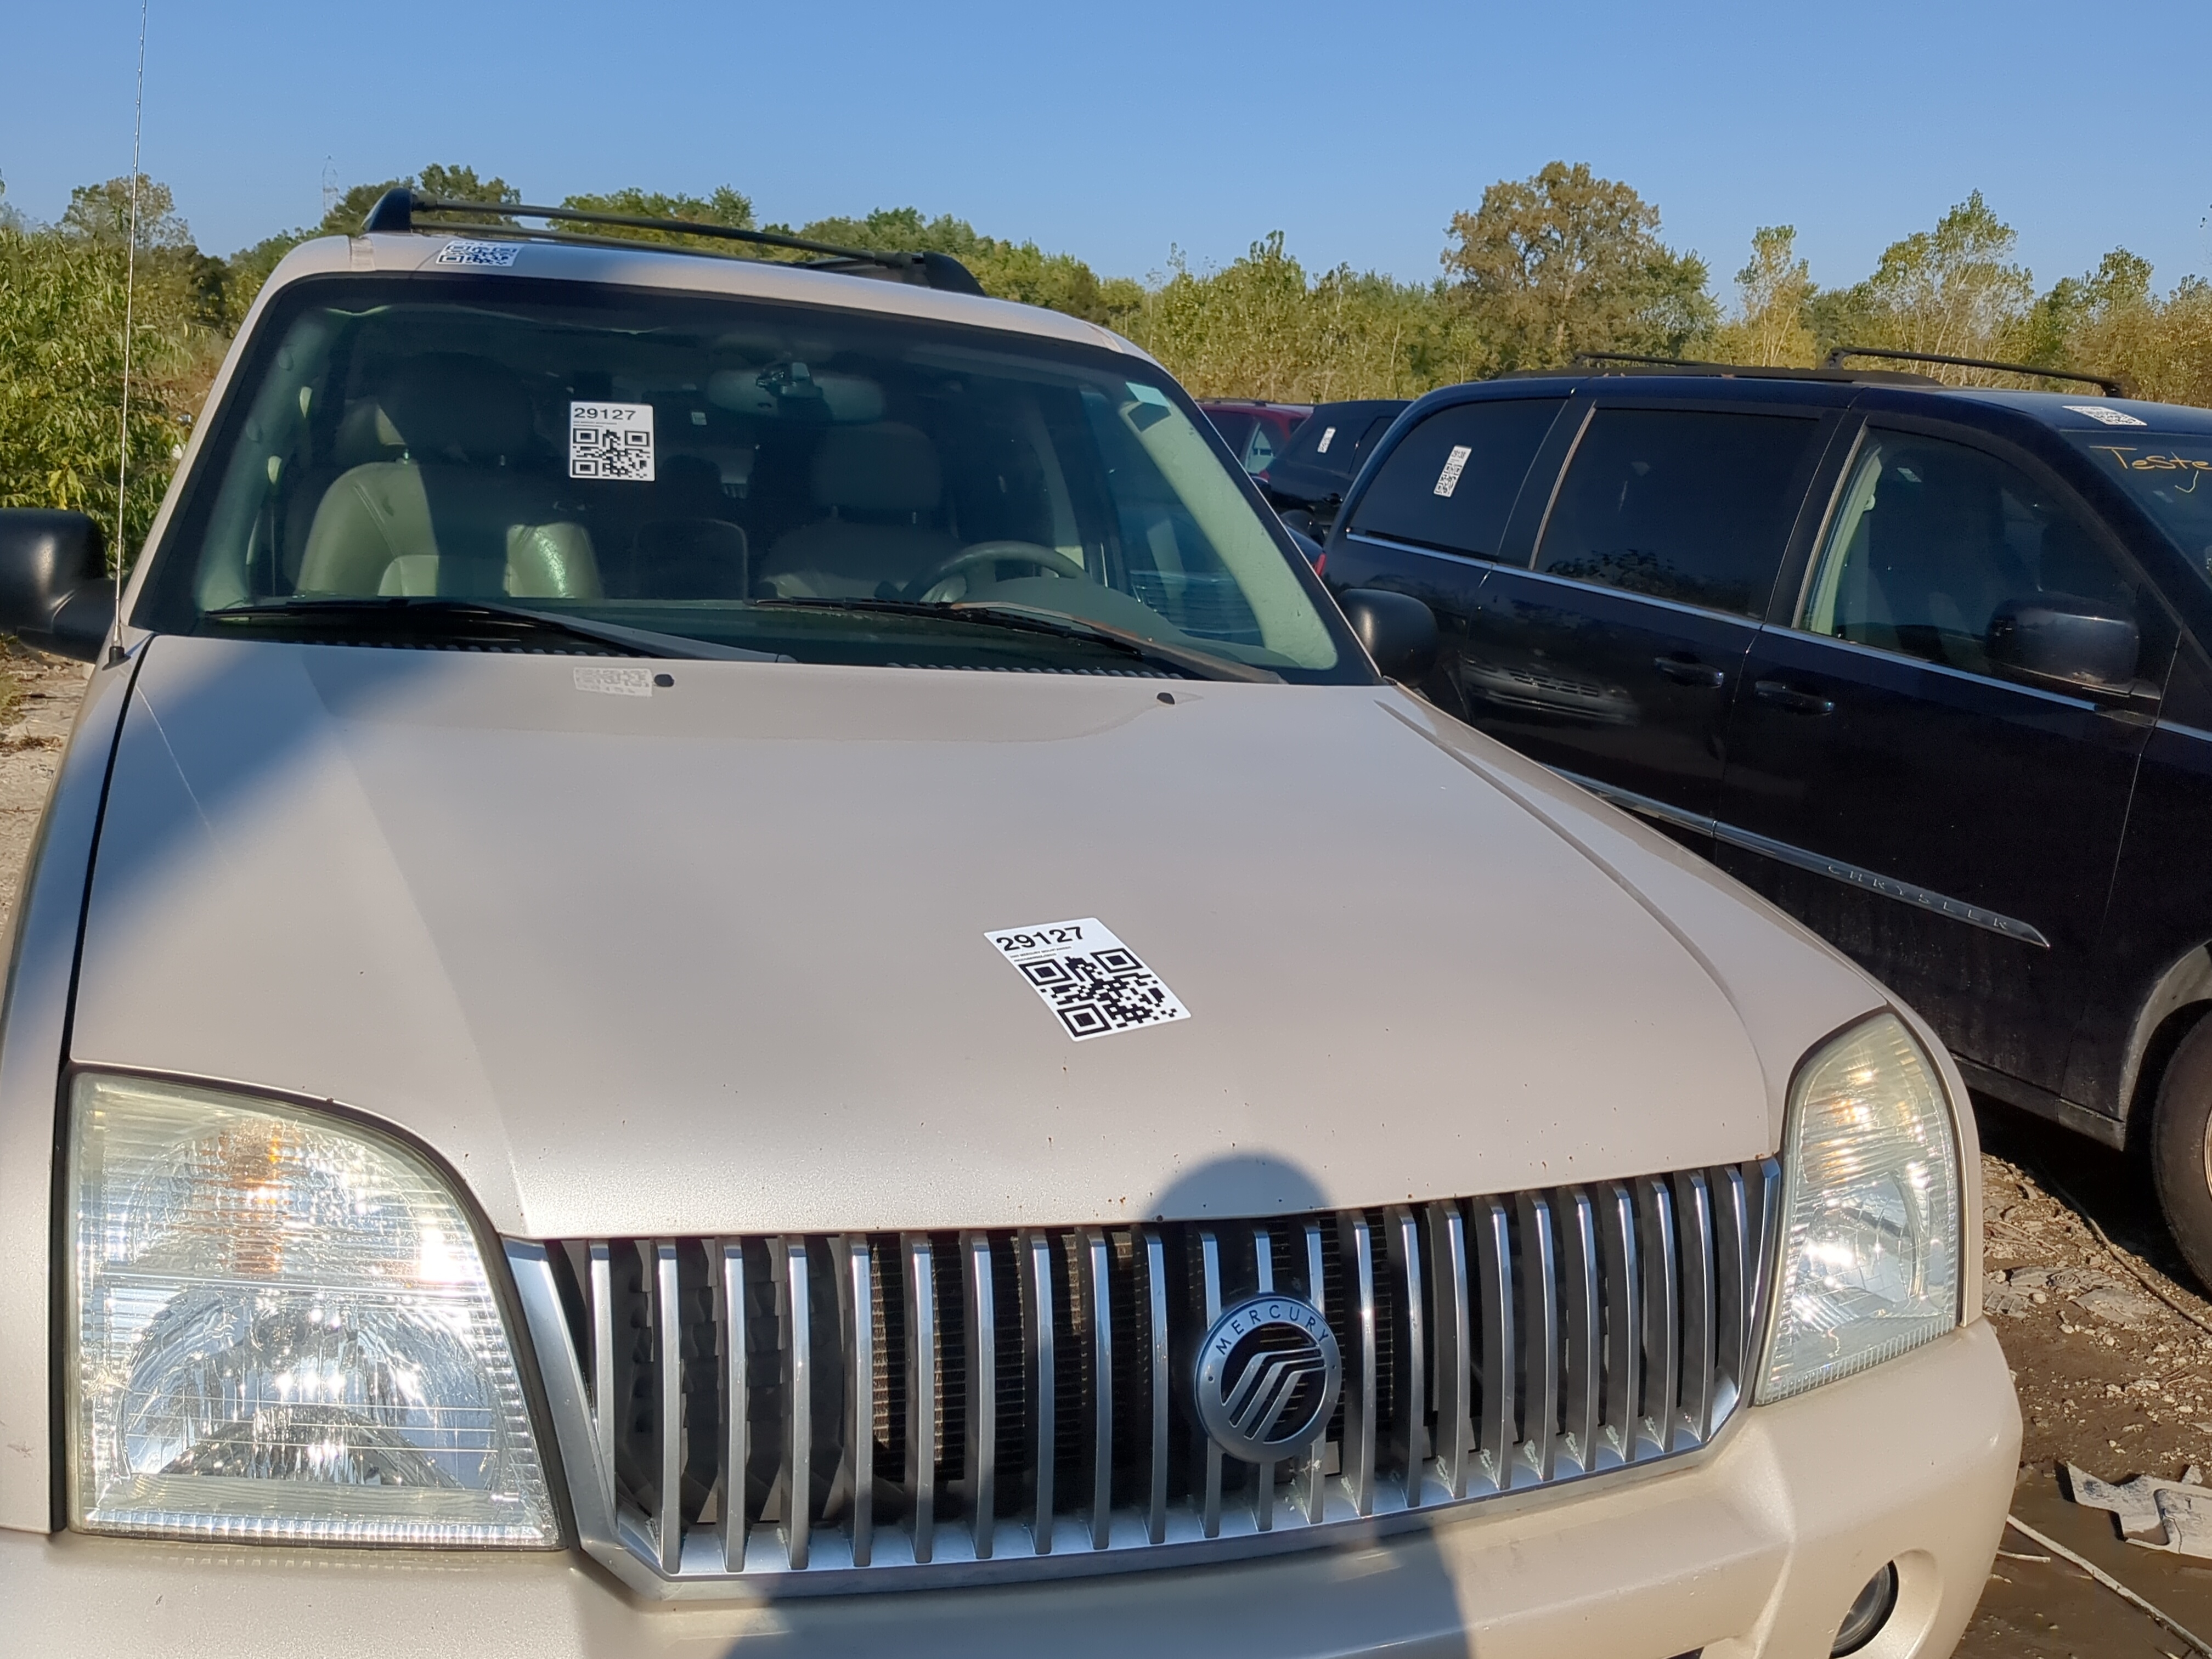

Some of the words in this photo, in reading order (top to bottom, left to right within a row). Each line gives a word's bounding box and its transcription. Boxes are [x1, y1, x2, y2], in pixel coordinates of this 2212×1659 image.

[574, 408, 636, 421] 29127
[996, 926, 1083, 951] 29127
[1215, 1304, 1329, 1355] MERCURY
